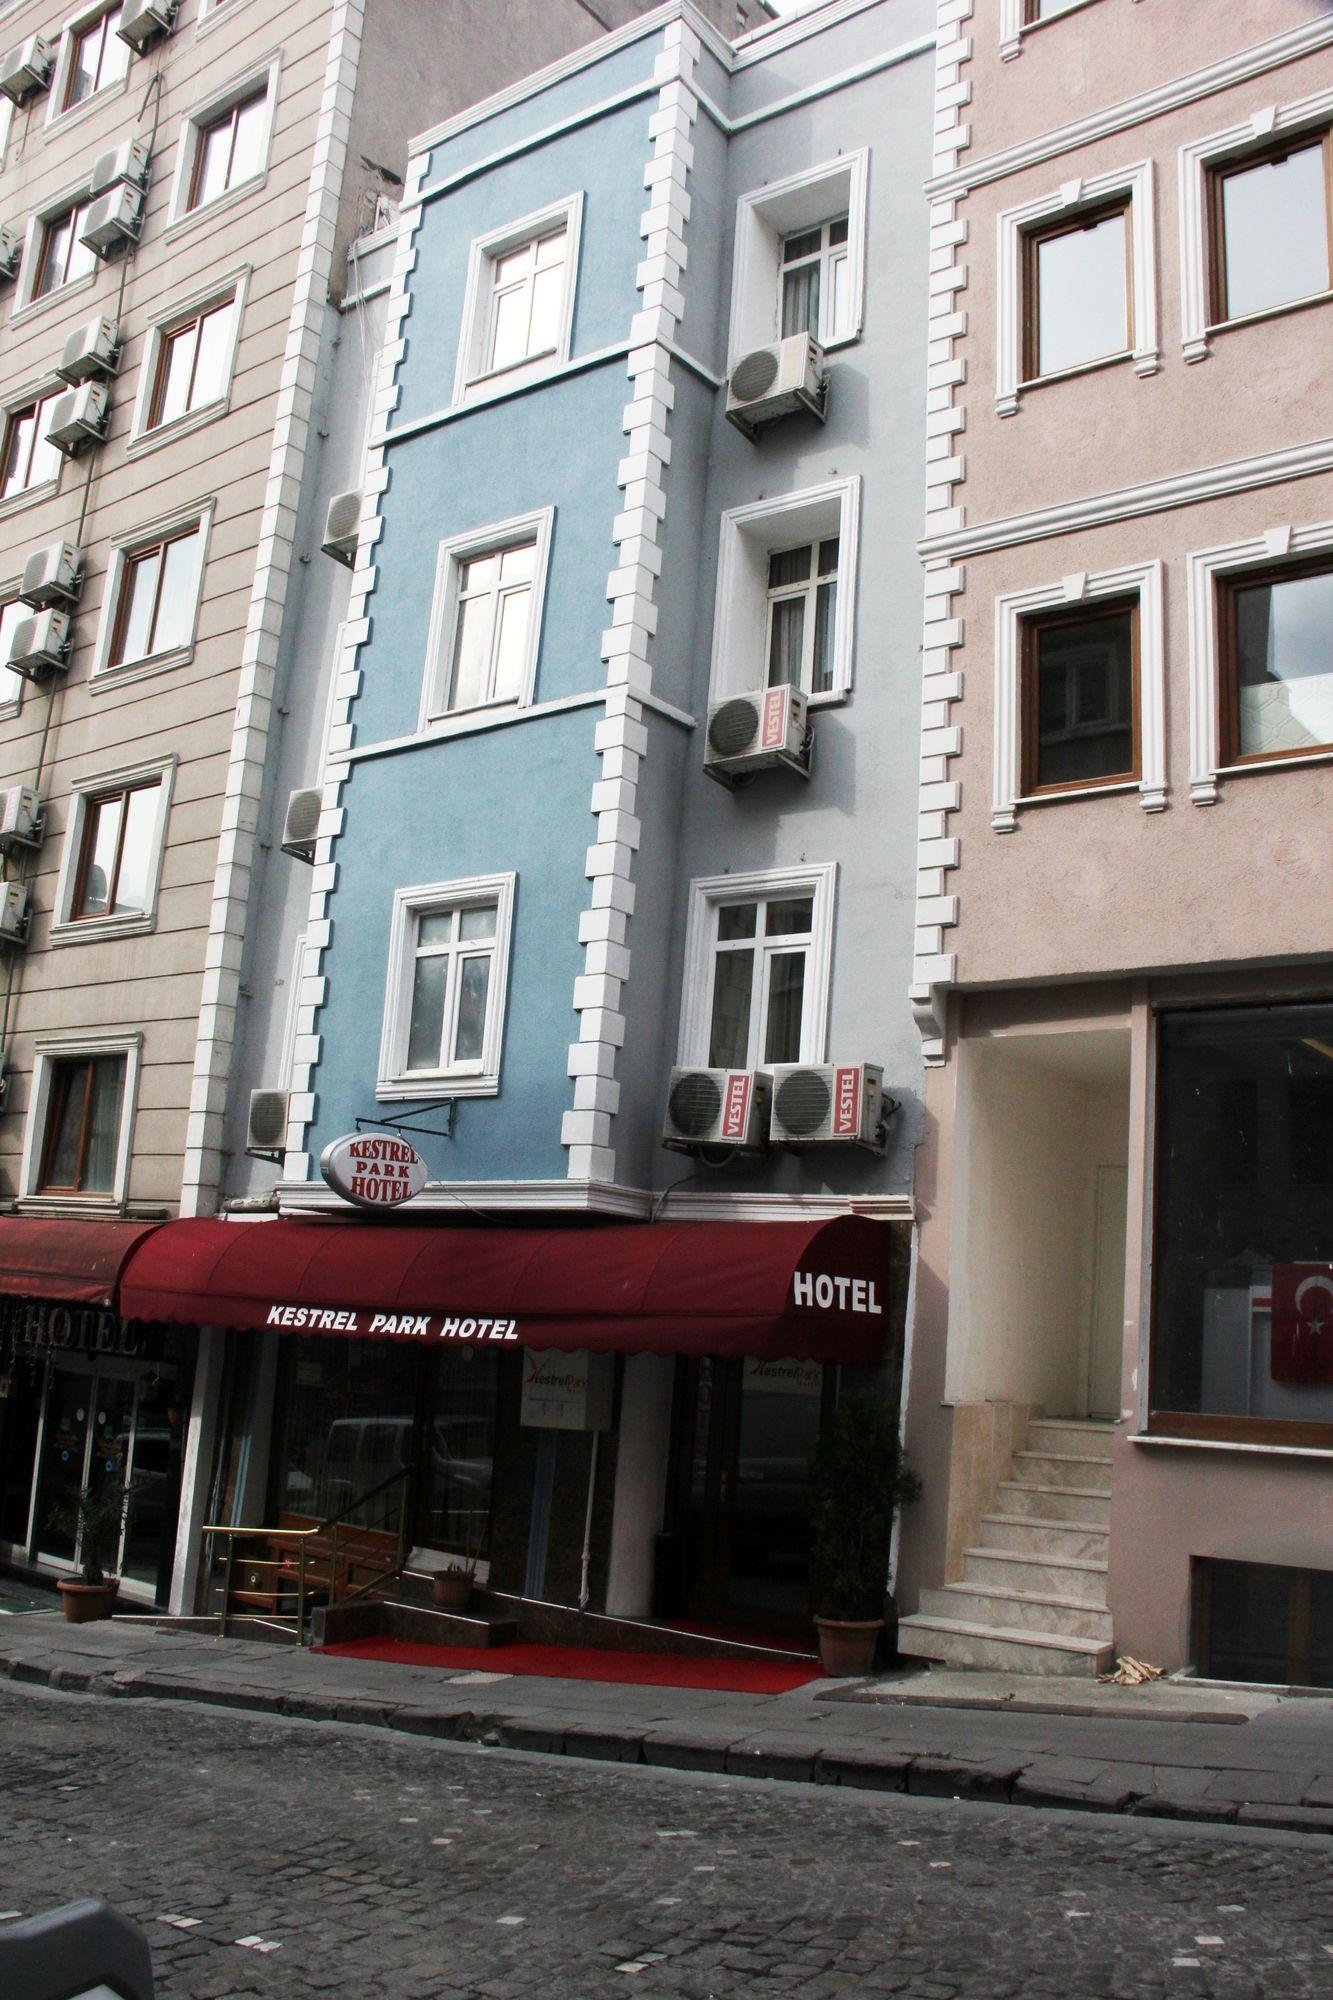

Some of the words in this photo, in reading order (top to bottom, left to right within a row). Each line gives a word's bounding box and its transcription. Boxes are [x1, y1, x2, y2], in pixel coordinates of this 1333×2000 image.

[766, 692, 781, 745] VESTEL
[727, 1077, 746, 1136] VESTEL
[839, 1070, 855, 1132] VESTEL
[349, 1139, 419, 1165] KESTREL
[356, 1161, 410, 1178] PARK
[351, 1176, 412, 1202] HOTEL
[793, 1271, 882, 1314] HOTEL
[23, 1304, 138, 1355] HOTEL
[266, 1305, 358, 1331] KESTREL
[368, 1313, 432, 1335] PARK
[439, 1317, 519, 1340] HOTEL
